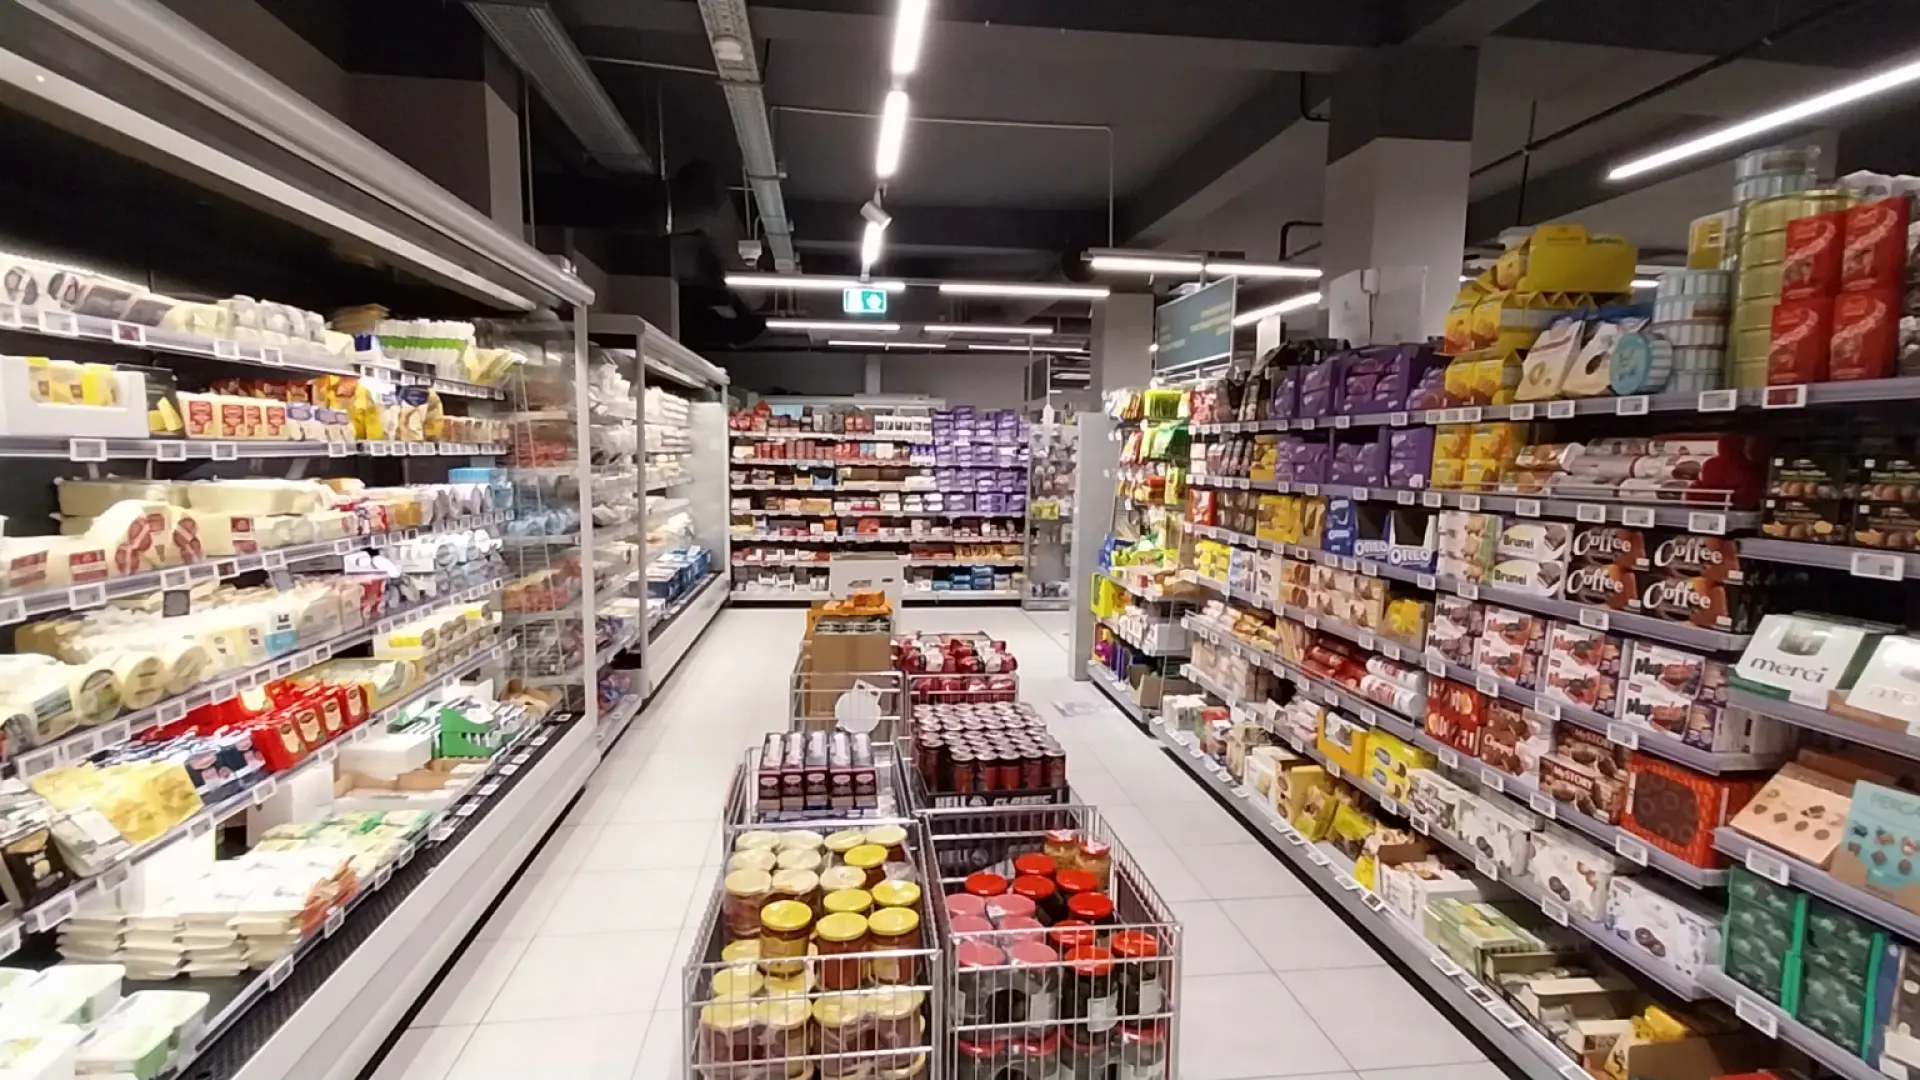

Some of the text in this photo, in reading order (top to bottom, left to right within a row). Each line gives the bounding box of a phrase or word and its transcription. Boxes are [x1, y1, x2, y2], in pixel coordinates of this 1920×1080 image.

[1573, 530, 1632, 555] Coffee
[1654, 538, 1724, 567] Coffee
[1390, 548, 1430, 565] OREO
[1566, 569, 1625, 594] Coffee
[1643, 580, 1712, 609] Coffee
[1750, 657, 1829, 683] merci
